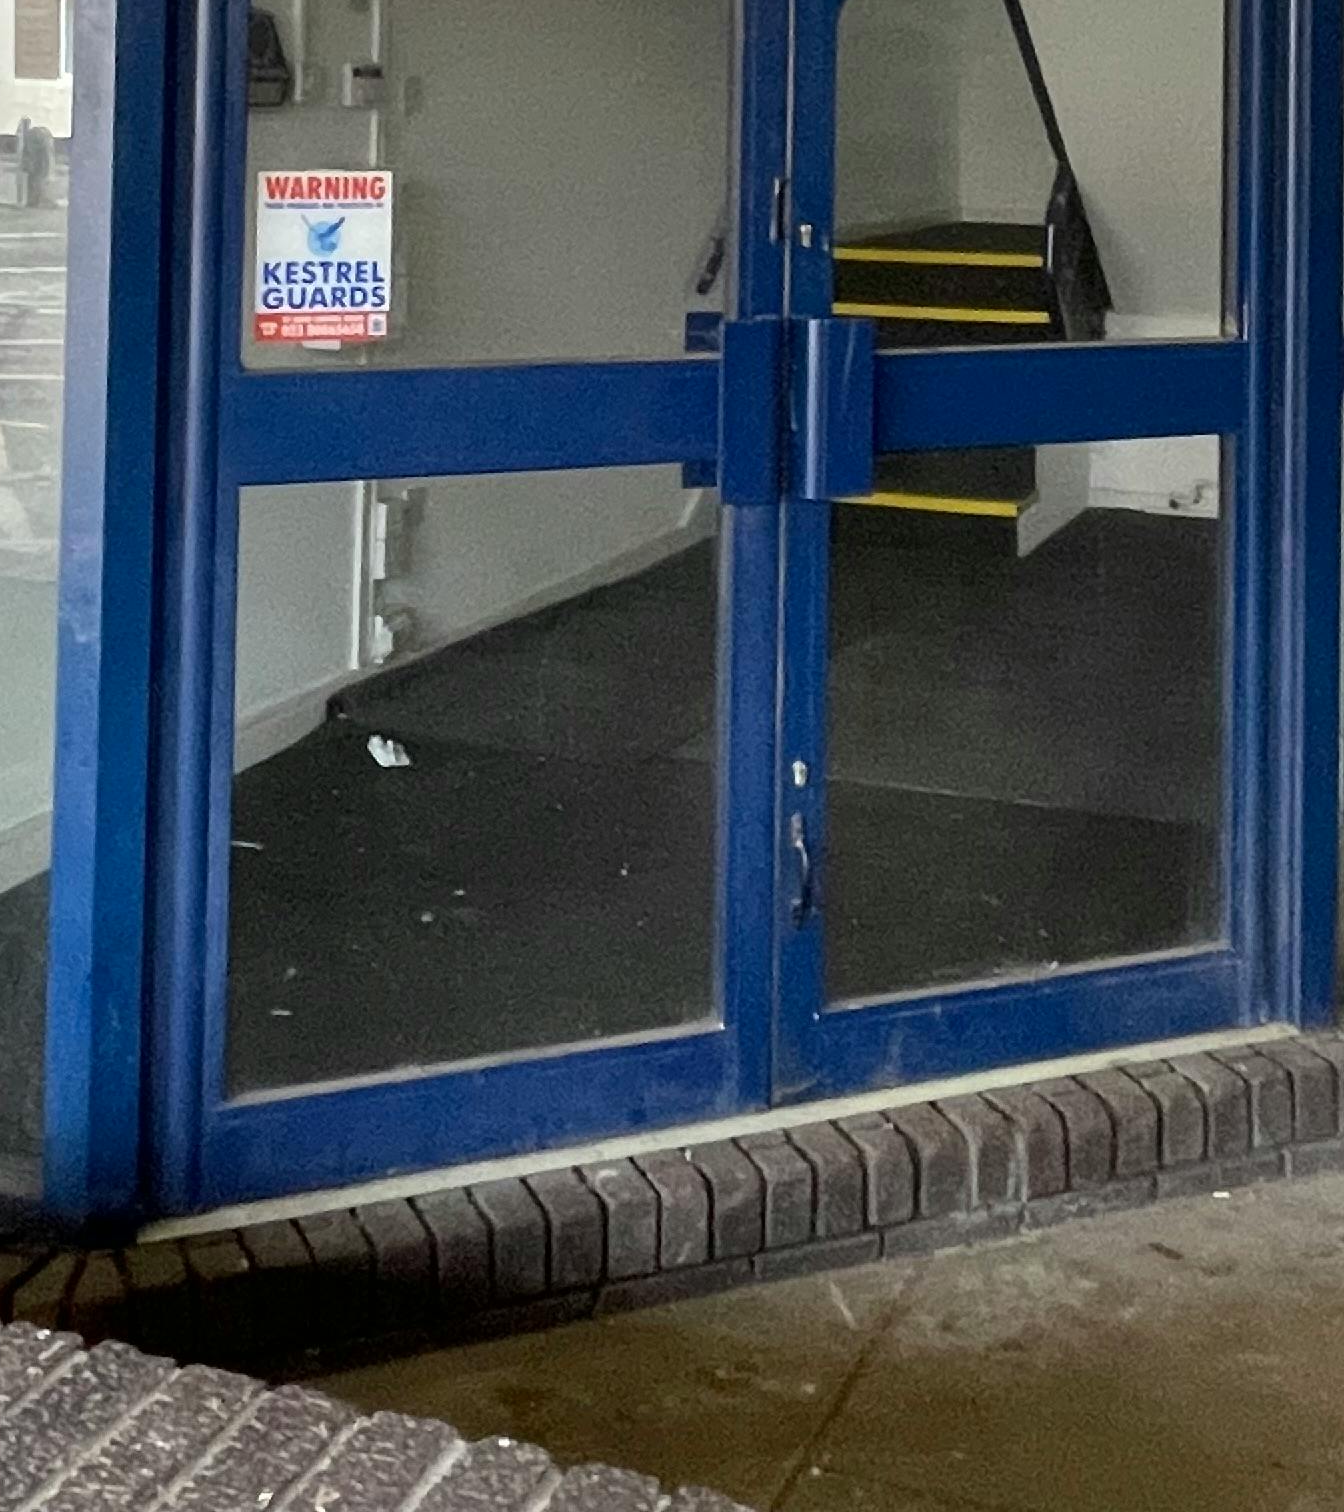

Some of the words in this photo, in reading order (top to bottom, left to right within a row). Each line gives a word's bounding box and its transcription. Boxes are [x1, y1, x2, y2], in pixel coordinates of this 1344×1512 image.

[264, 176, 386, 200] WARNING
[263, 261, 385, 285] KESTREL
[262, 287, 386, 310] GUARDS
